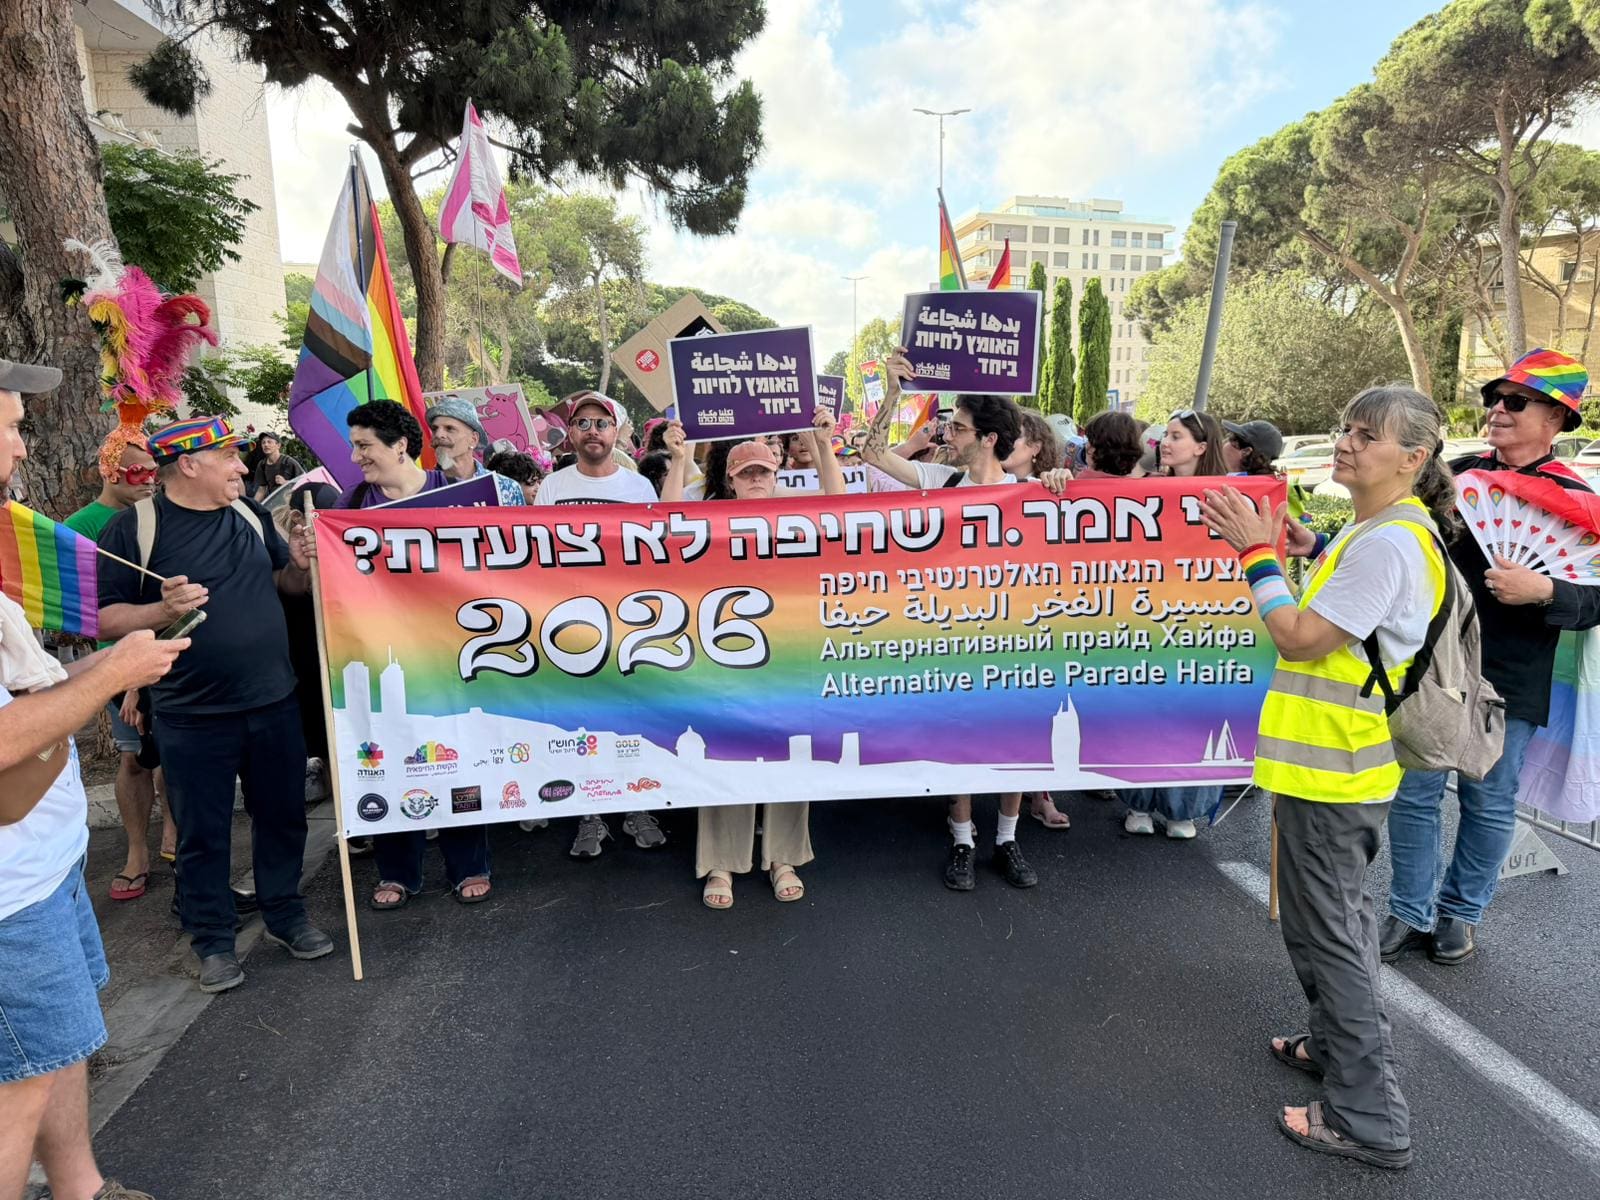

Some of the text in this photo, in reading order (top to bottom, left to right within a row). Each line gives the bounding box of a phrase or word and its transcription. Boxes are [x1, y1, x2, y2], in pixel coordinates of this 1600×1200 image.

[918, 306, 1021, 337] بدها شجاعة
[915, 330, 1019, 357] האומץ לחיות
[691, 351, 797, 375] بدها شجاعة
[692, 375, 799, 397] האומץ לחיות
[622, 512, 711, 566] לא
[728, 506, 945, 559] שחיפה
[961, 496, 1161, 548] אמר.ה
[342, 522, 606, 576] צועדת?
[818, 569, 888, 597] חיפה
[897, 559, 1061, 593] האלטרנטיבי
[1071, 558, 1164, 586] הגאווה
[818, 587, 1253, 636] مسيرة الفخر البديلة حيفا
[455, 585, 774, 683] 2026
[819, 622, 1256, 663] Альтернативный прайд Хайфа
[820, 657, 1253, 698] Alternative Pride Parade Haifa
[615, 740, 640, 748] GOLD
